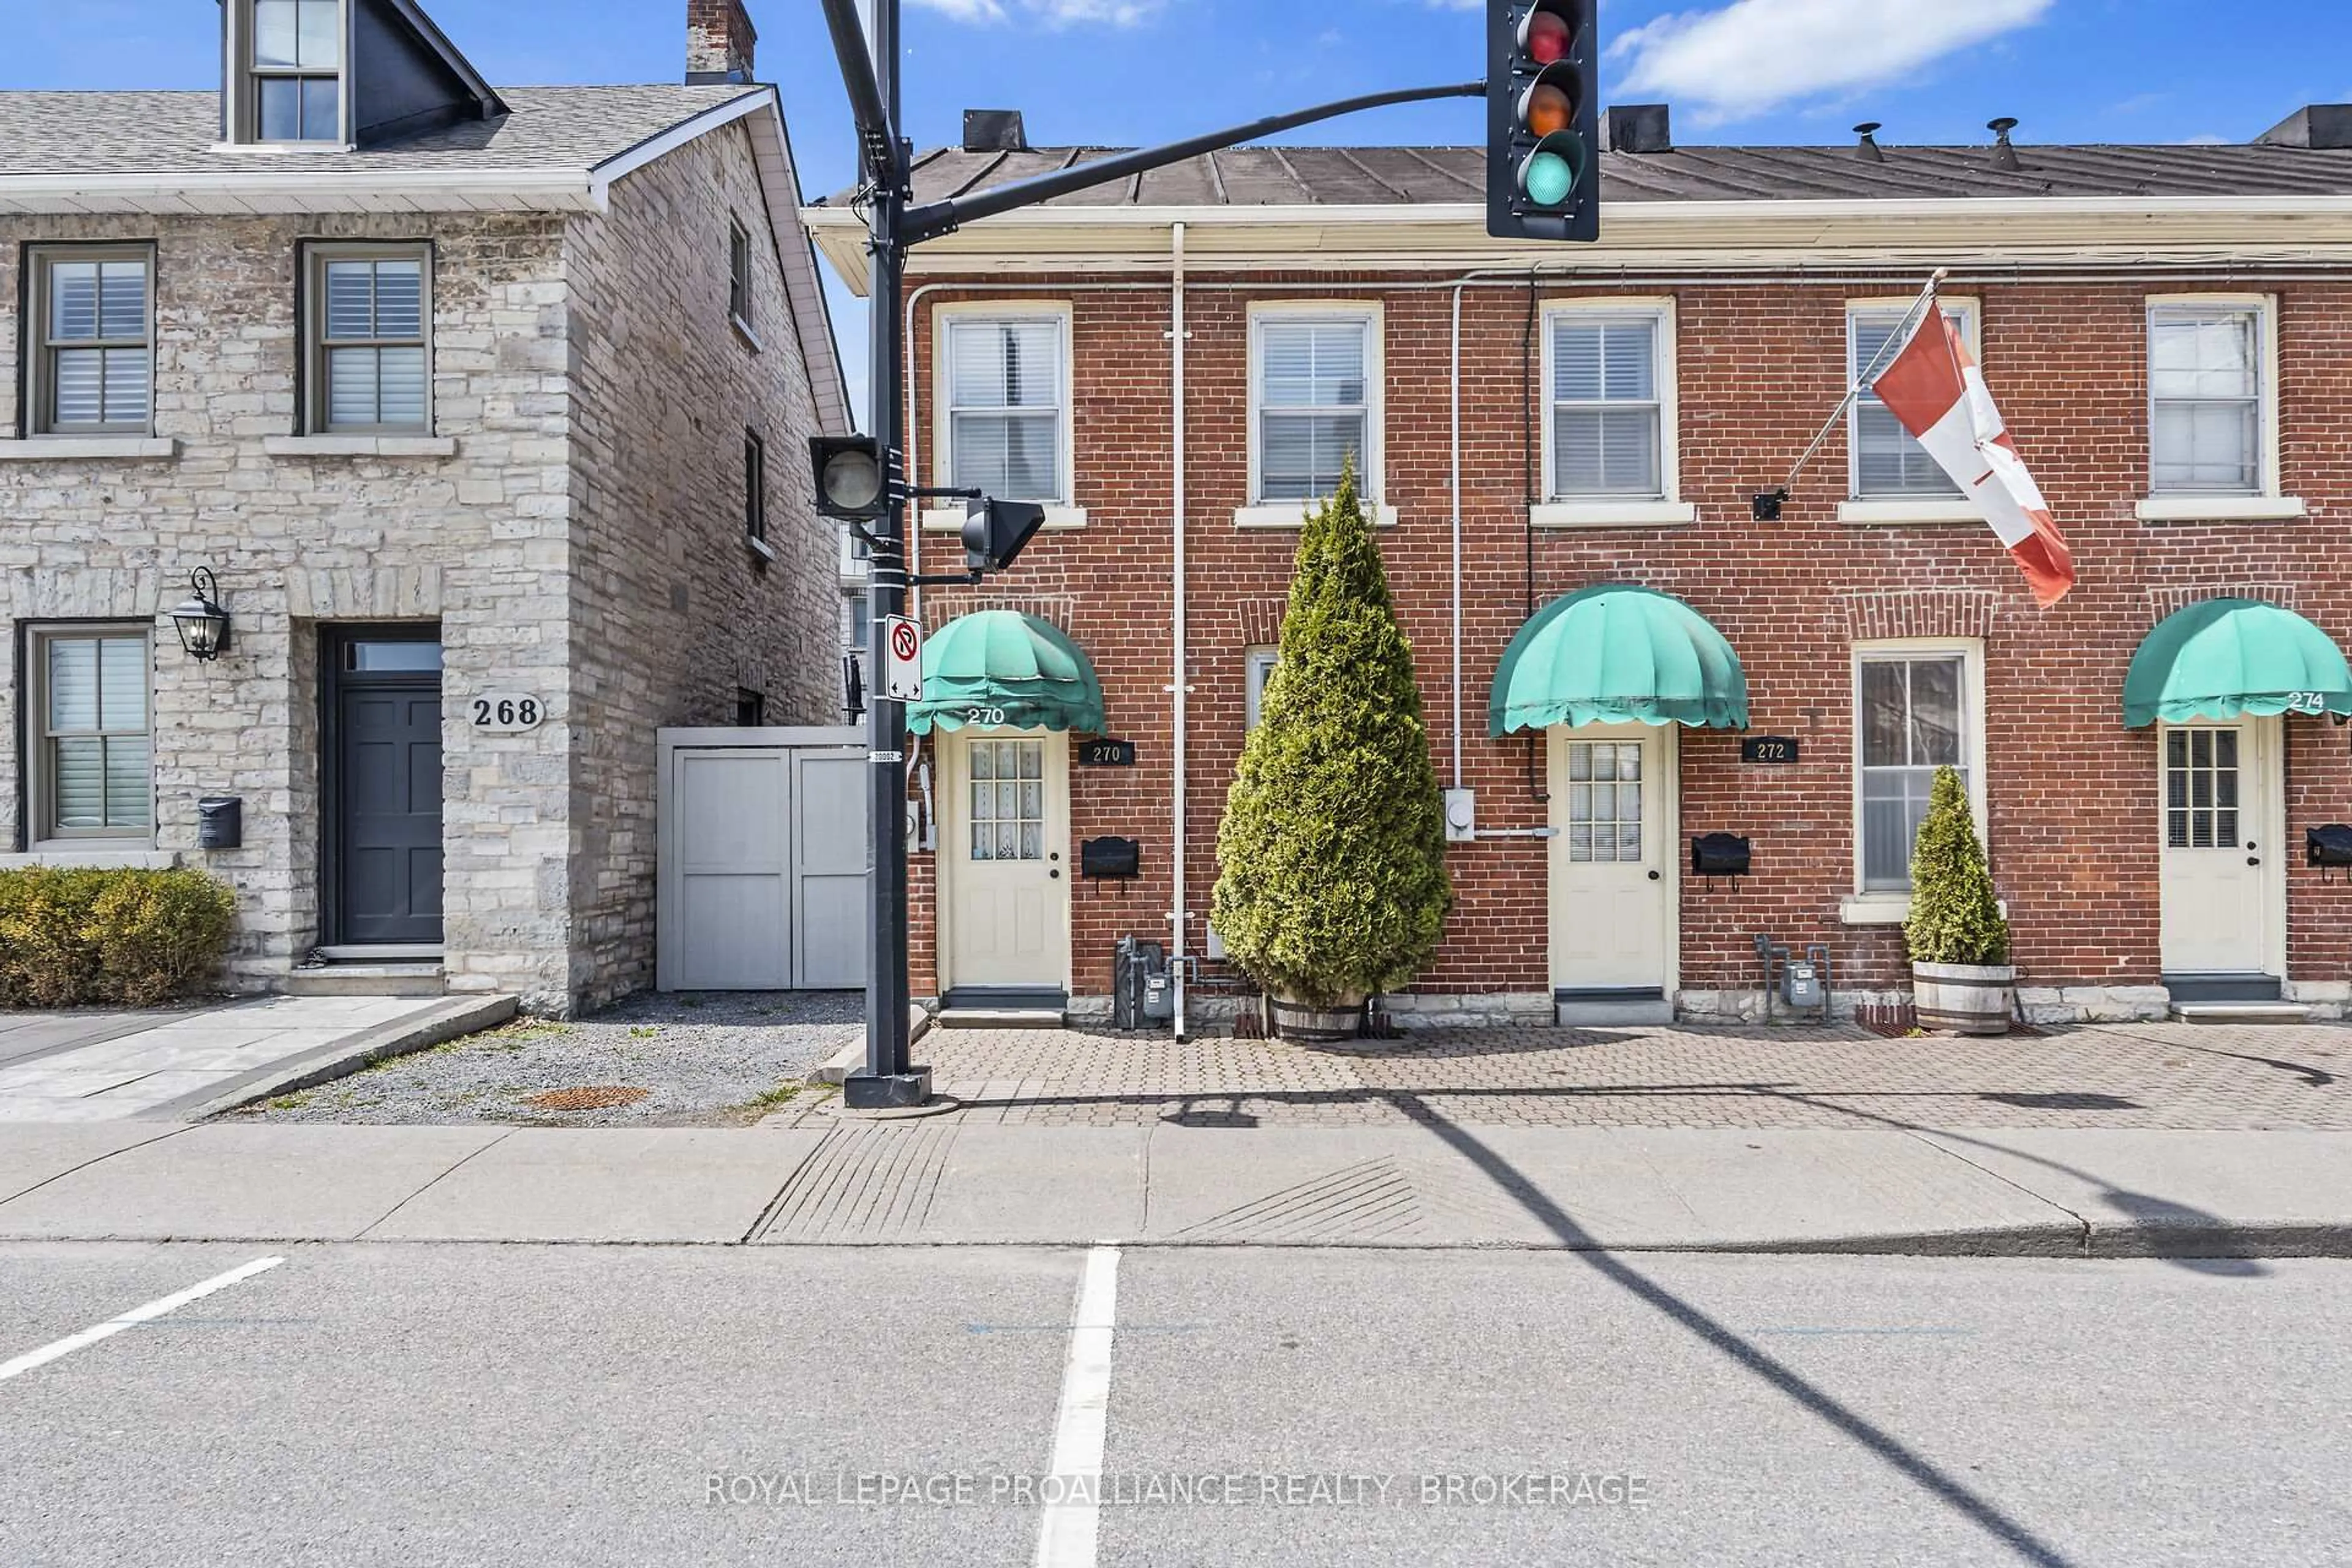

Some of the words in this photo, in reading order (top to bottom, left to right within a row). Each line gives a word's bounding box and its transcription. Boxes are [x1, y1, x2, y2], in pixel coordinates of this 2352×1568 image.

[2287, 692, 2324, 709] 274
[473, 699, 537, 726] 268
[968, 707, 1005, 724] 270
[1093, 746, 1120, 762] 270
[1757, 743, 1785, 759] 272
